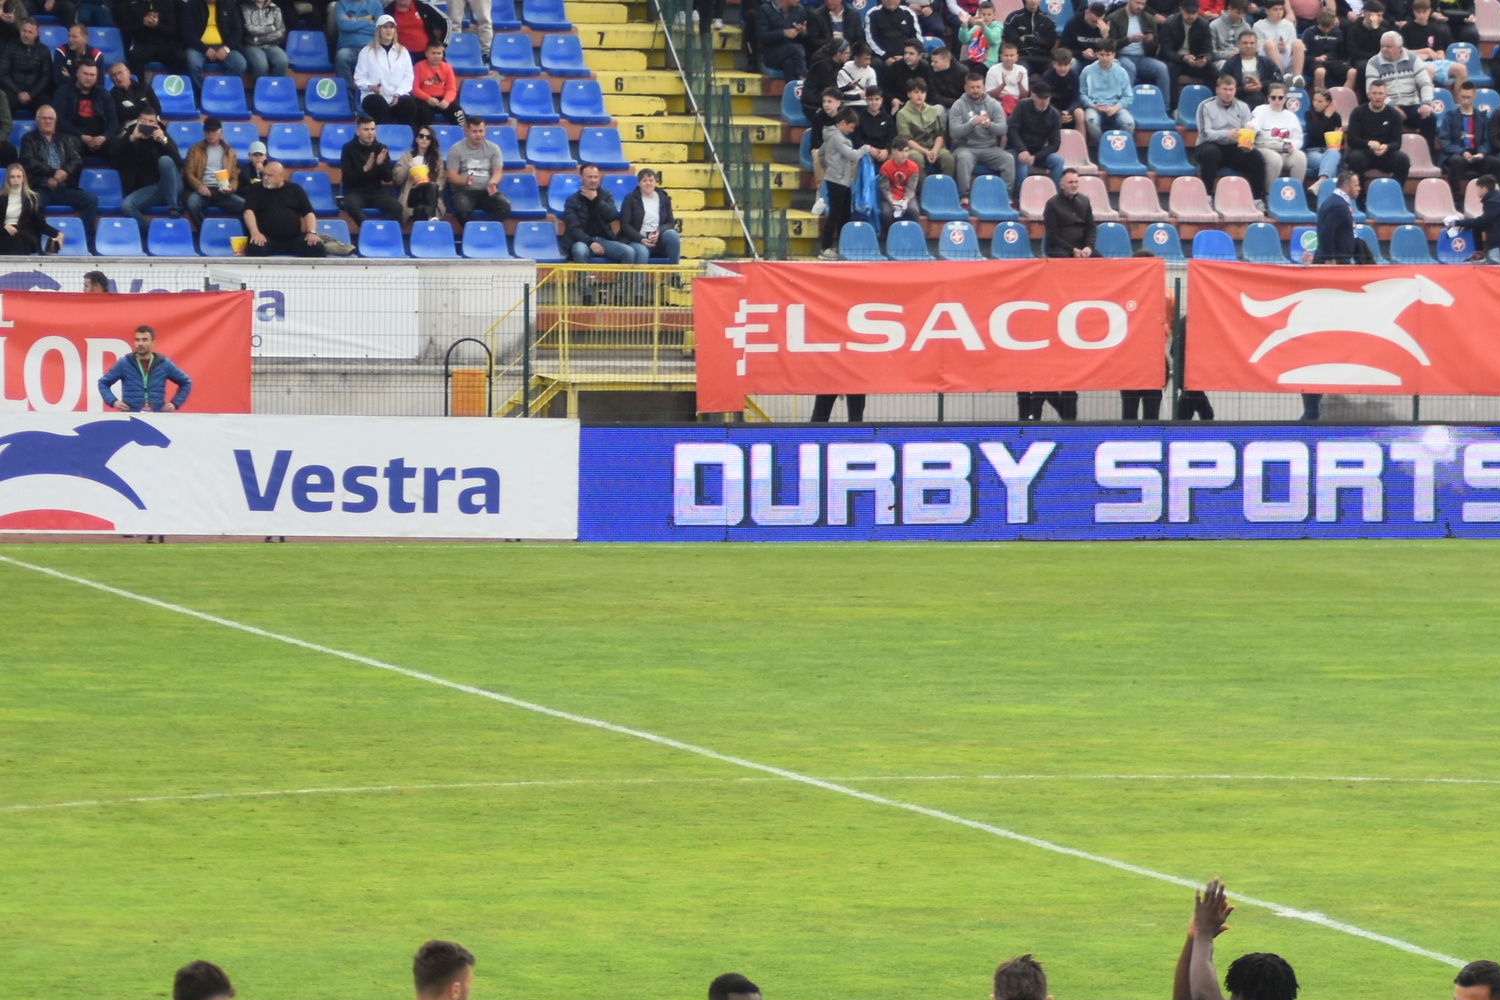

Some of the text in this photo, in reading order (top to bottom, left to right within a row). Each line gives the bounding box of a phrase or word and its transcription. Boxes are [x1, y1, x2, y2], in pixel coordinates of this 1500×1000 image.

[597, 32, 605, 46] 7
[614, 77, 624, 92] 6
[736, 78, 746, 93] 6
[636, 125, 645, 140] 5
[756, 126, 765, 141] 5
[773, 172, 783, 187] 4
[793, 220, 803, 235] 3
[234, 449, 501, 515] Vestra
[673, 441, 1056, 526] DURBY
